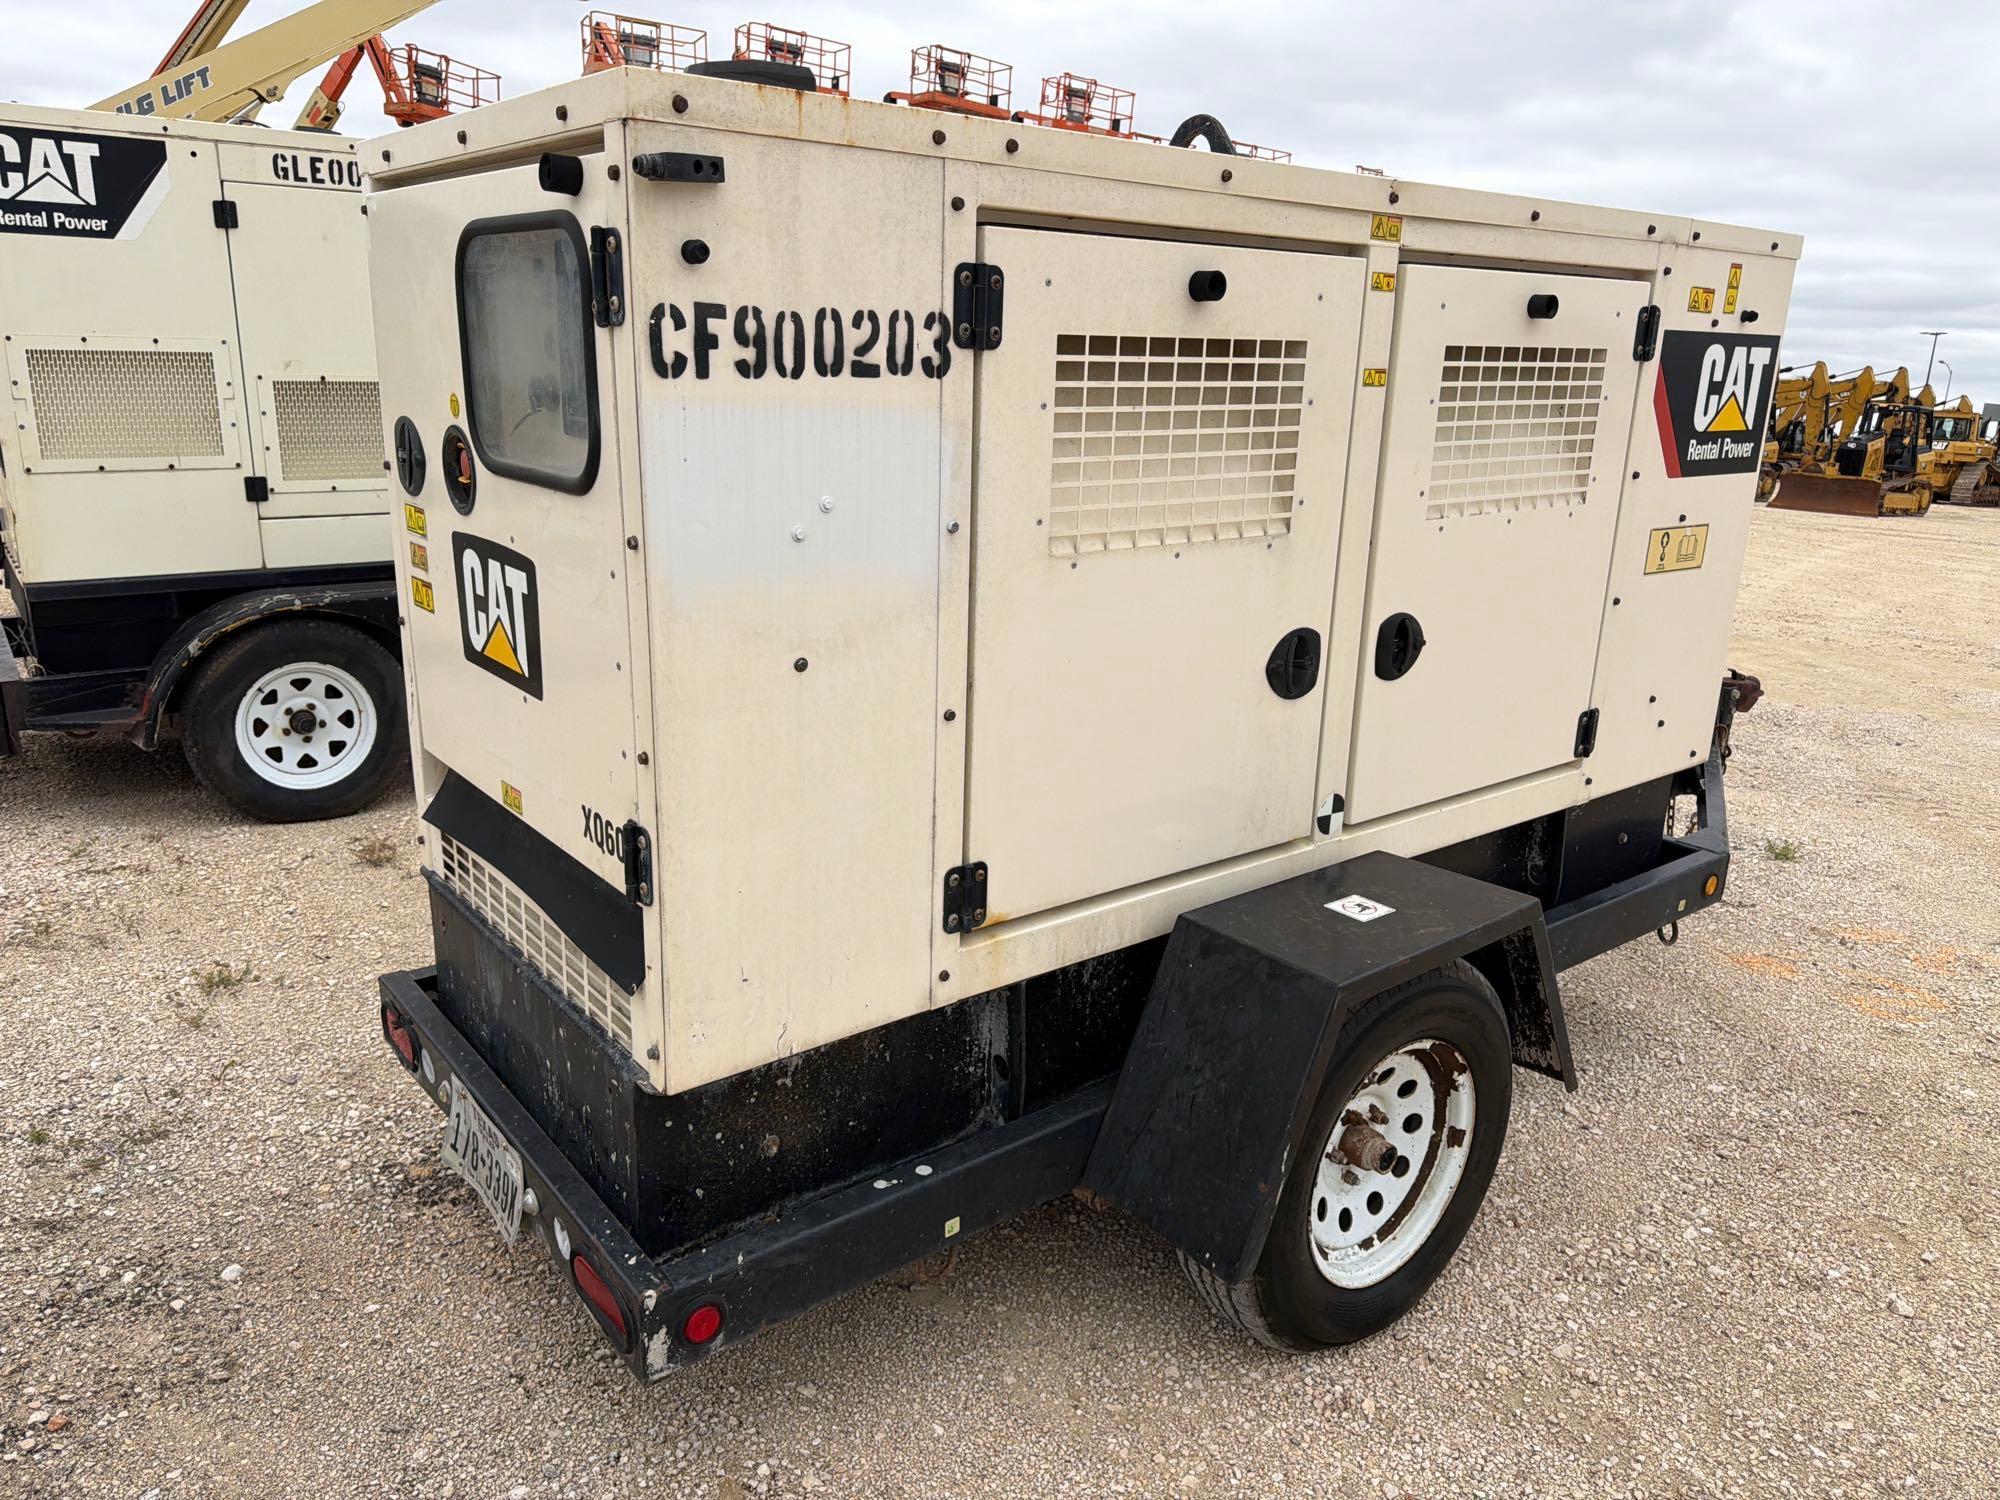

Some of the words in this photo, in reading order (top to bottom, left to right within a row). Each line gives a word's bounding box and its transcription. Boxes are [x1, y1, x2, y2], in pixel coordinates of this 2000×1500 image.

[161, 65, 210, 107] LIFT
[0, 133, 101, 206] CAT
[53, 212, 108, 231] Power
[650, 301, 952, 380] CF900203
[1693, 343, 1772, 433] CAT
[1687, 438, 1721, 461] Rental
[1722, 437, 1755, 459] Power
[462, 548, 530, 679] CAT
[581, 804, 625, 864] XQ60
